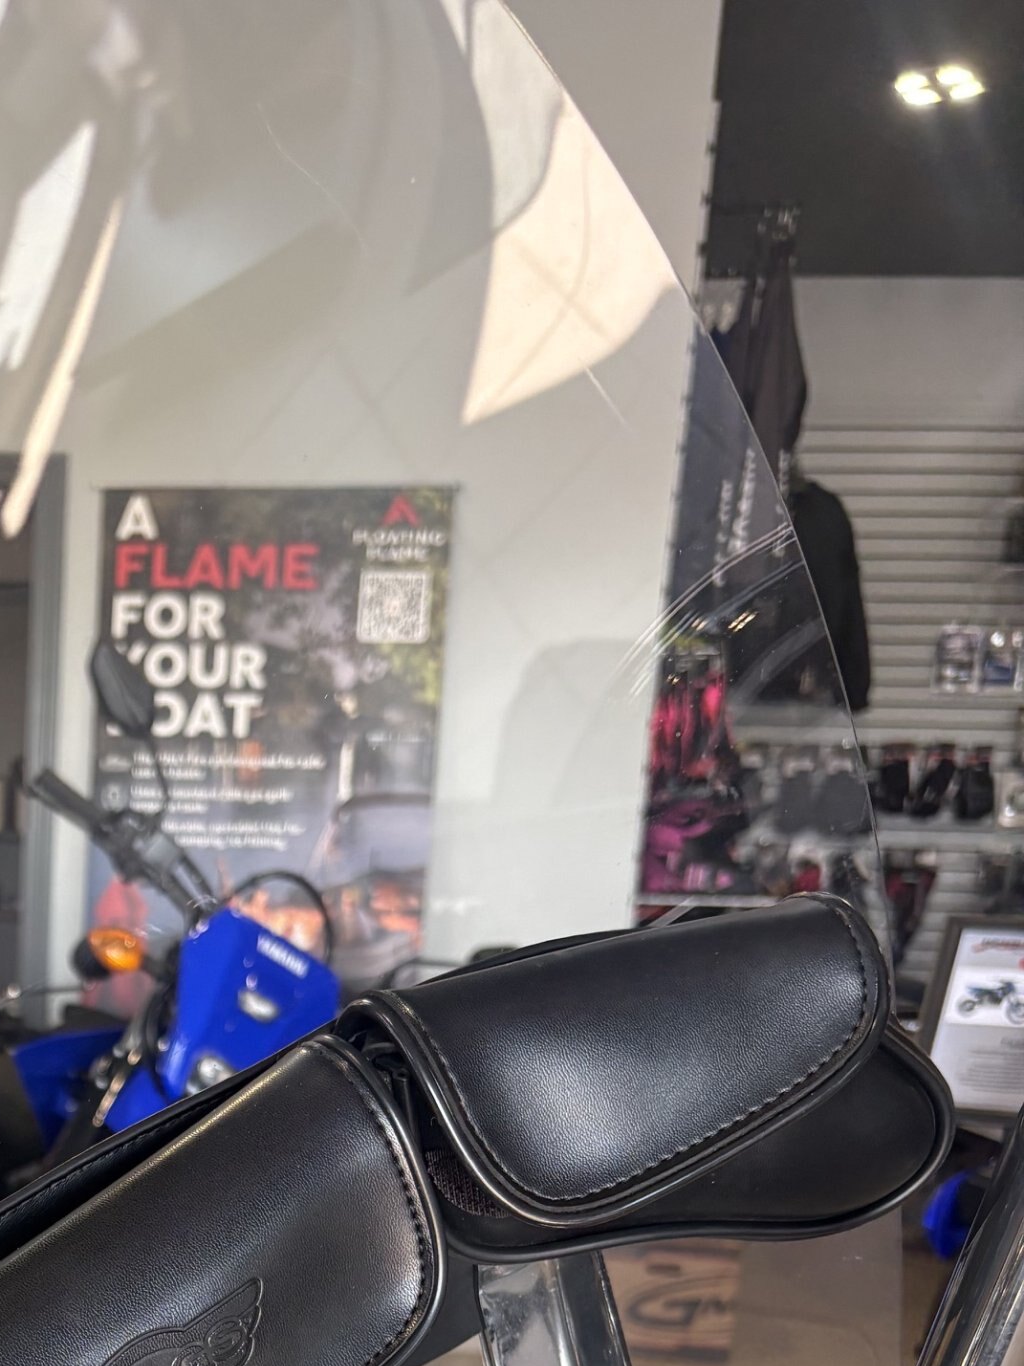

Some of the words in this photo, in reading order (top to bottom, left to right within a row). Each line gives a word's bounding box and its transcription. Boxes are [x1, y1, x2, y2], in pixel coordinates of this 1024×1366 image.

[116, 495, 158, 540] A
[114, 543, 320, 589] FLAME
[111, 592, 225, 639] FOR
[106, 691, 264, 738] OAT
